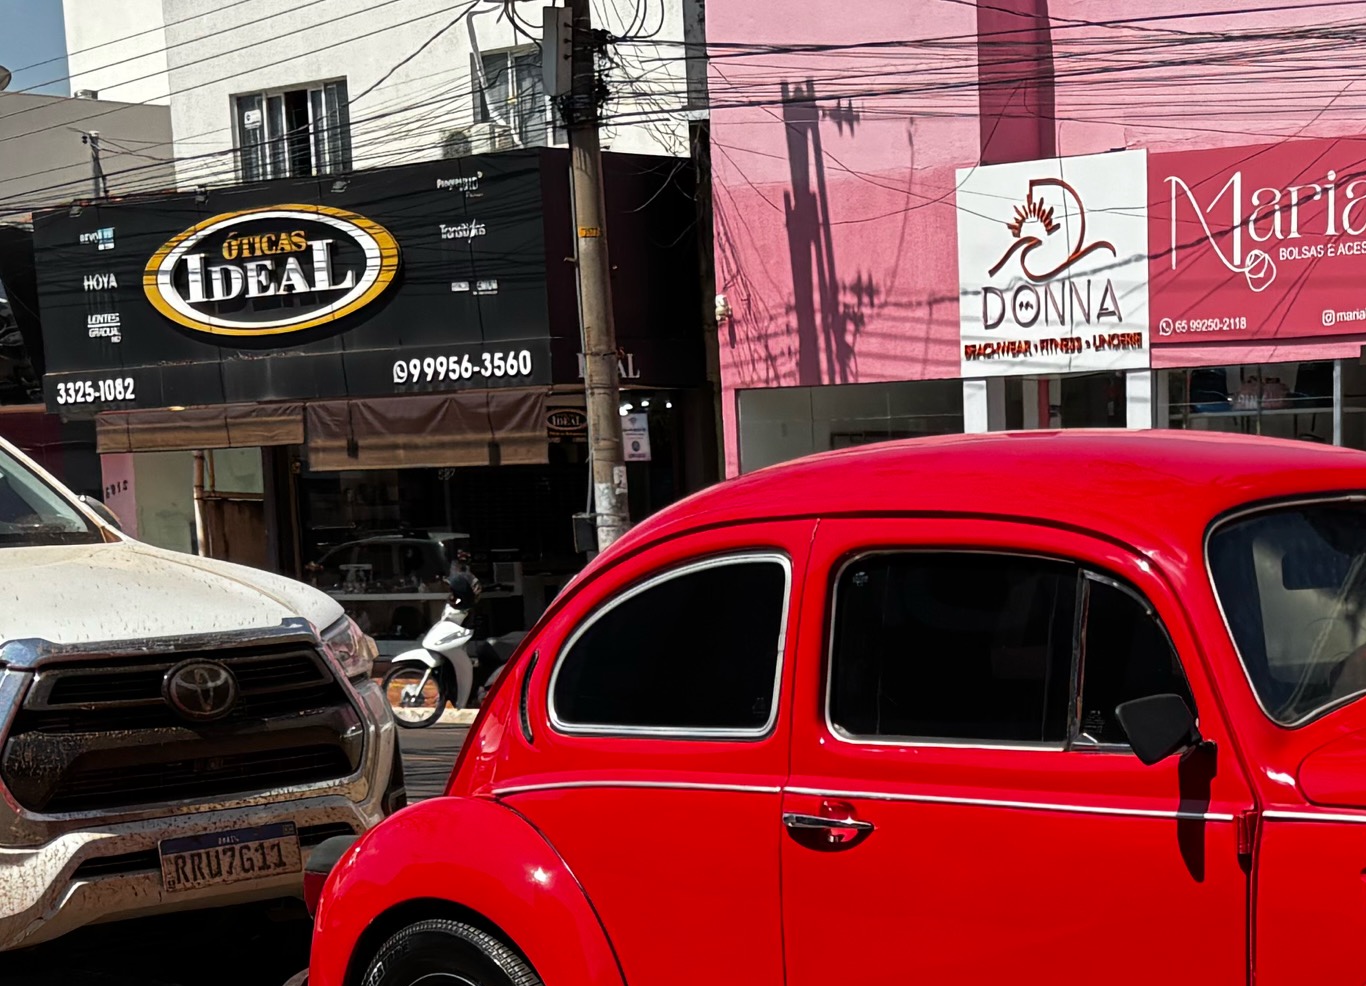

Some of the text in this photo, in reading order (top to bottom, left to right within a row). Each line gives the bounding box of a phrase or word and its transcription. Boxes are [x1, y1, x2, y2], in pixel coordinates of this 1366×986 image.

[222, 231, 308, 260] ÓTICAS
[1279, 244, 1324, 261] BOLSAS
[1327, 243, 1336, 257] E
[83, 273, 118, 292] HOYA
[181, 239, 356, 304] IDEAL
[981, 278, 1123, 330] DONNA
[1175, 317, 1247, 333] 65 99250-2118
[1039, 336, 1083, 356] FITNESS
[408, 350, 532, 383] 99956-3560
[56, 377, 136, 405] 3325-1082
[174, 842, 287, 885] RRU7G11
